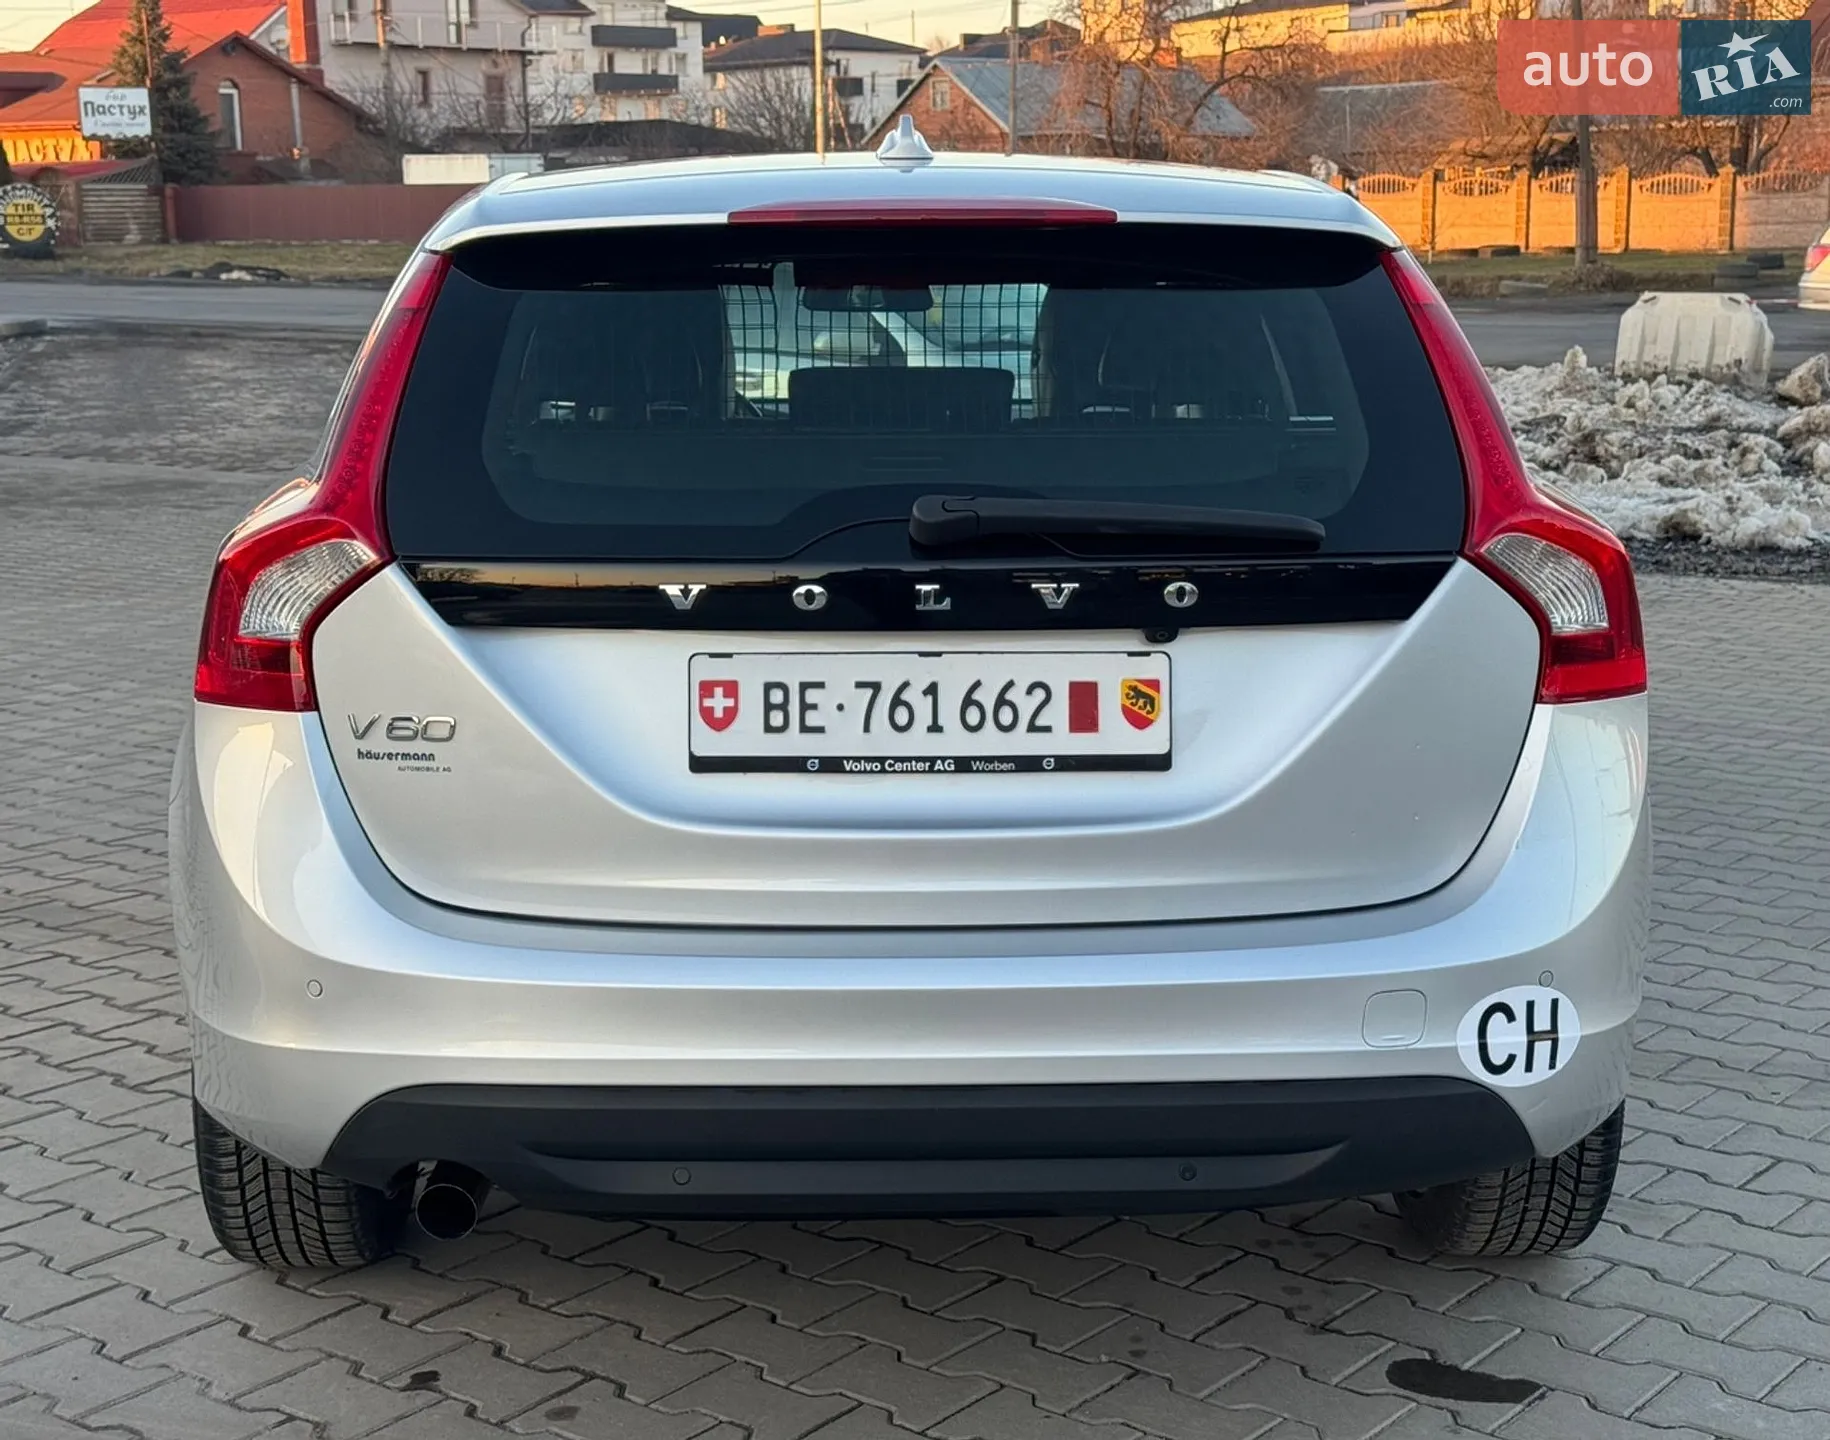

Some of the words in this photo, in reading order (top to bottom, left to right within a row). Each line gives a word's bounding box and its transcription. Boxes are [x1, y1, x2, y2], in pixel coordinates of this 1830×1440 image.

[83, 101, 147, 120] Пастух
[12, 203, 35, 213] TIR
[659, 582, 1198, 610] VOLVO
[347, 713, 456, 741] V60
[357, 748, 435, 761] häusermann
[843, 759, 881, 771] Volvo
[884, 760, 930, 771] Center
[933, 760, 955, 771] AG
[971, 760, 1015, 771] Worben
[1477, 998, 1559, 1076] CH
